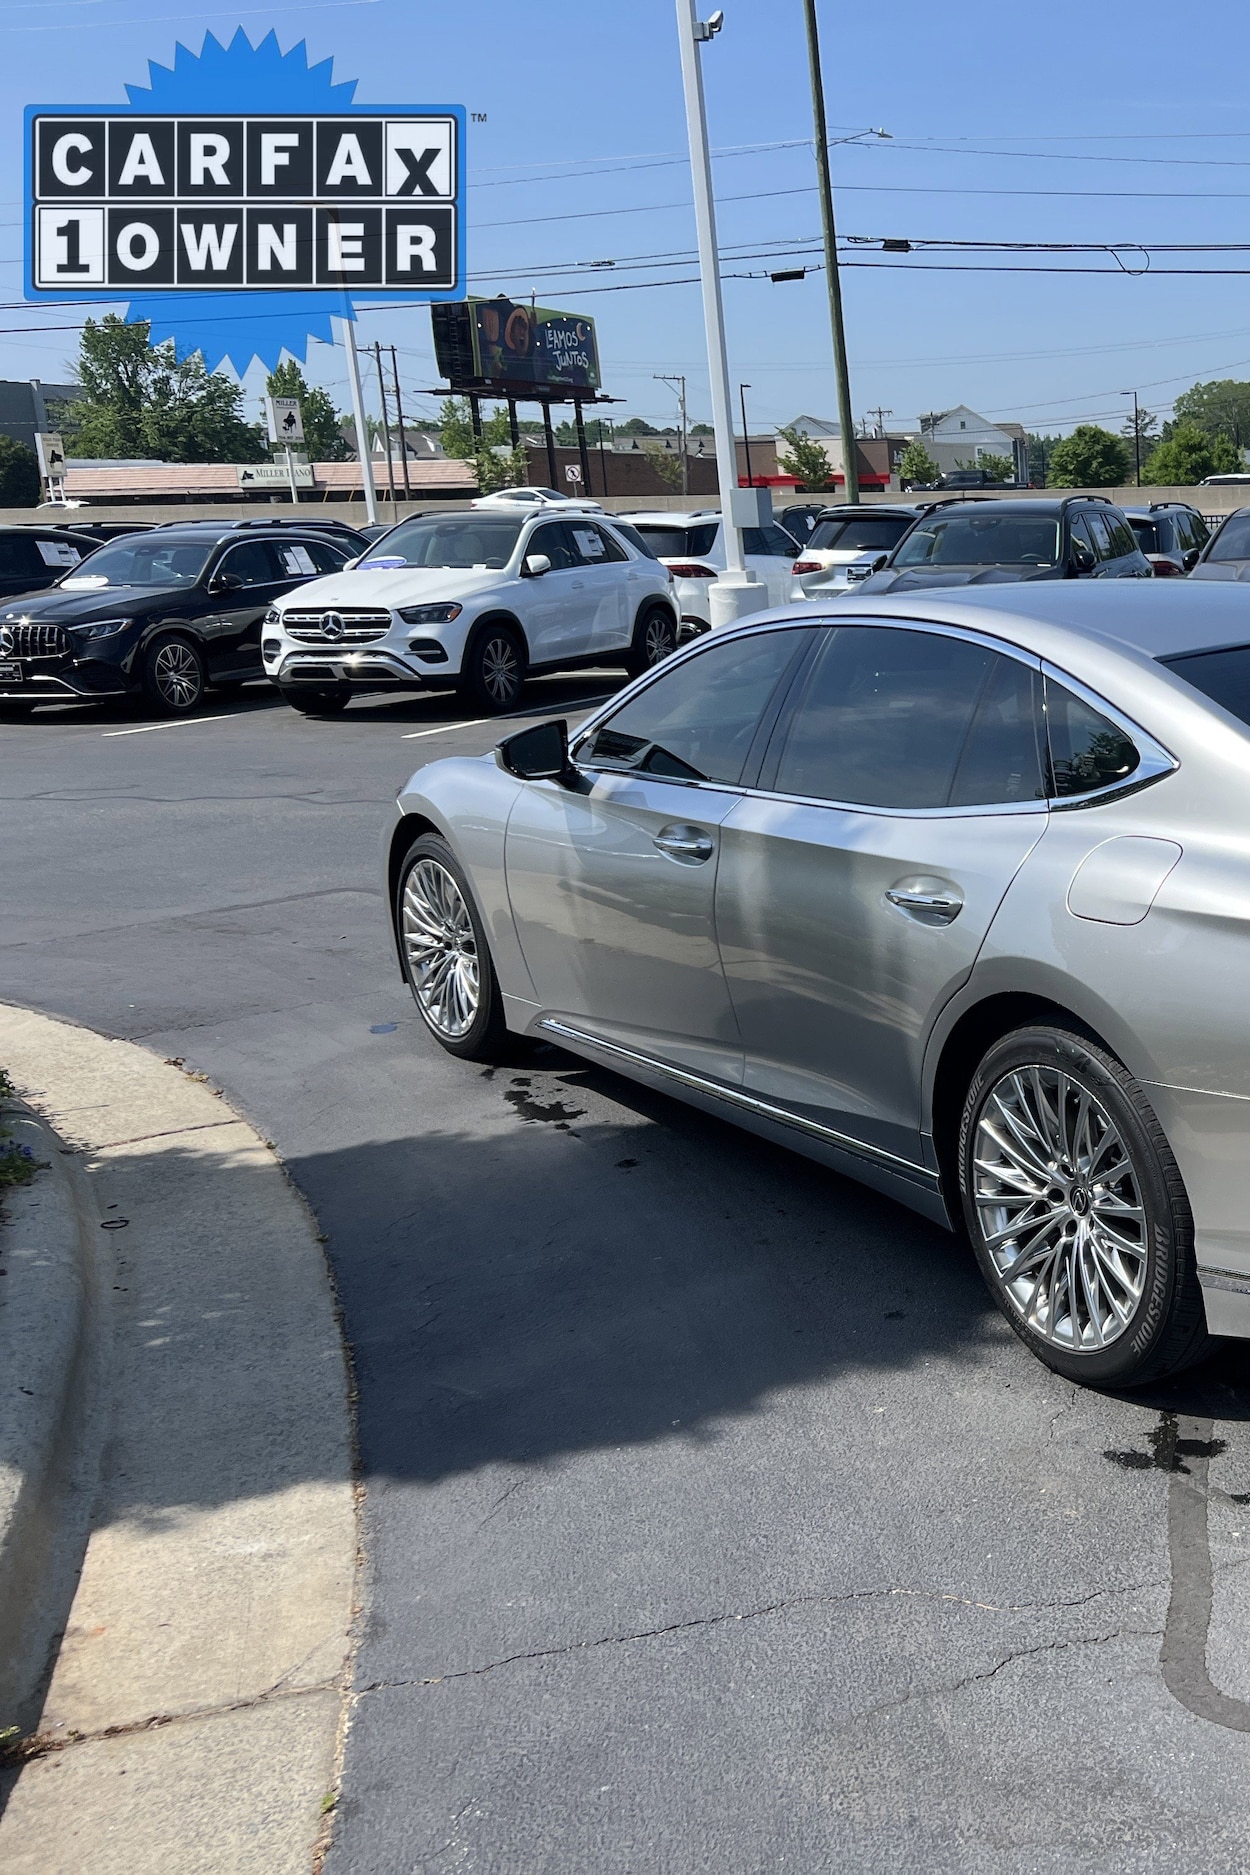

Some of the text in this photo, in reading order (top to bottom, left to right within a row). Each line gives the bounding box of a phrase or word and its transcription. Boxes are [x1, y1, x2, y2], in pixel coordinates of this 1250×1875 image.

[545, 329, 579, 350] LEAMOS
[256, 468, 311, 478] MILLER PANO
[1130, 1222, 1170, 1358] BRIDGESTONE
